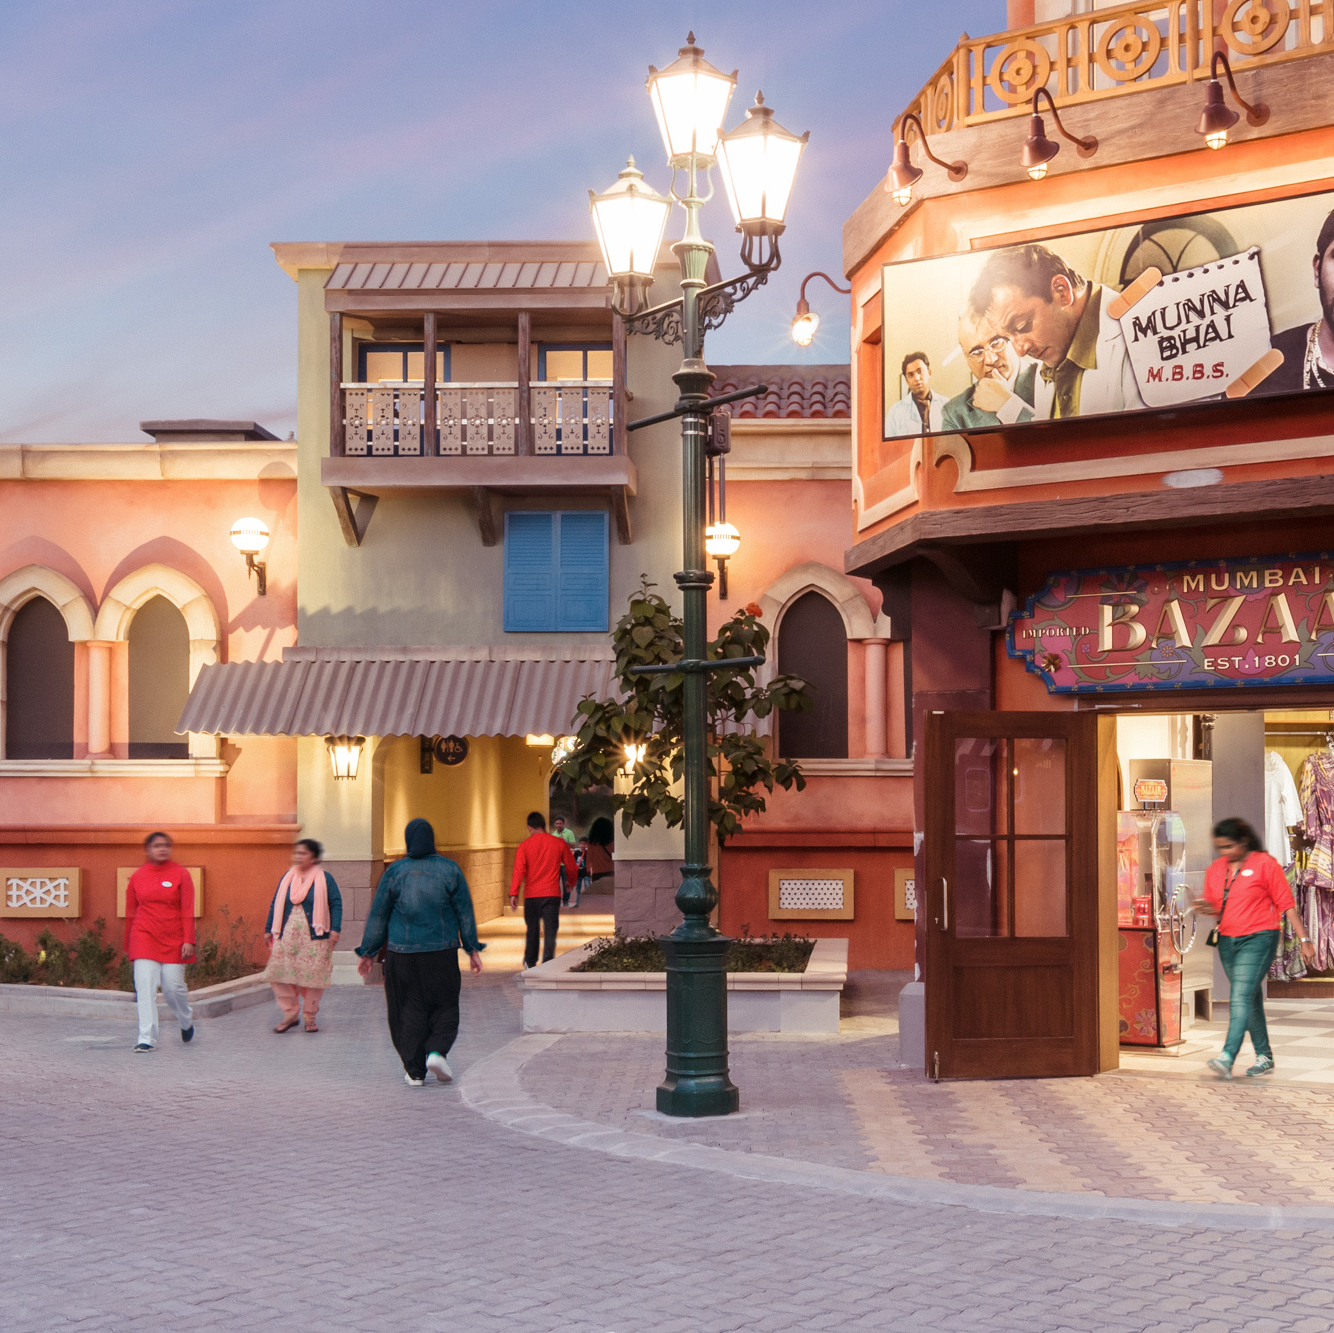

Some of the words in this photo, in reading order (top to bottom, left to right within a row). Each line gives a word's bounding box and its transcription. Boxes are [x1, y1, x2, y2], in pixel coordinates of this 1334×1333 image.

[1131, 279, 1257, 343] MUNNA
[1157, 313, 1234, 361] BHAI
[1146, 361, 1229, 383] M.B.B.S.
[1183, 566, 1321, 593] MUMBAI
[1022, 625, 1091, 639] IMPORTED
